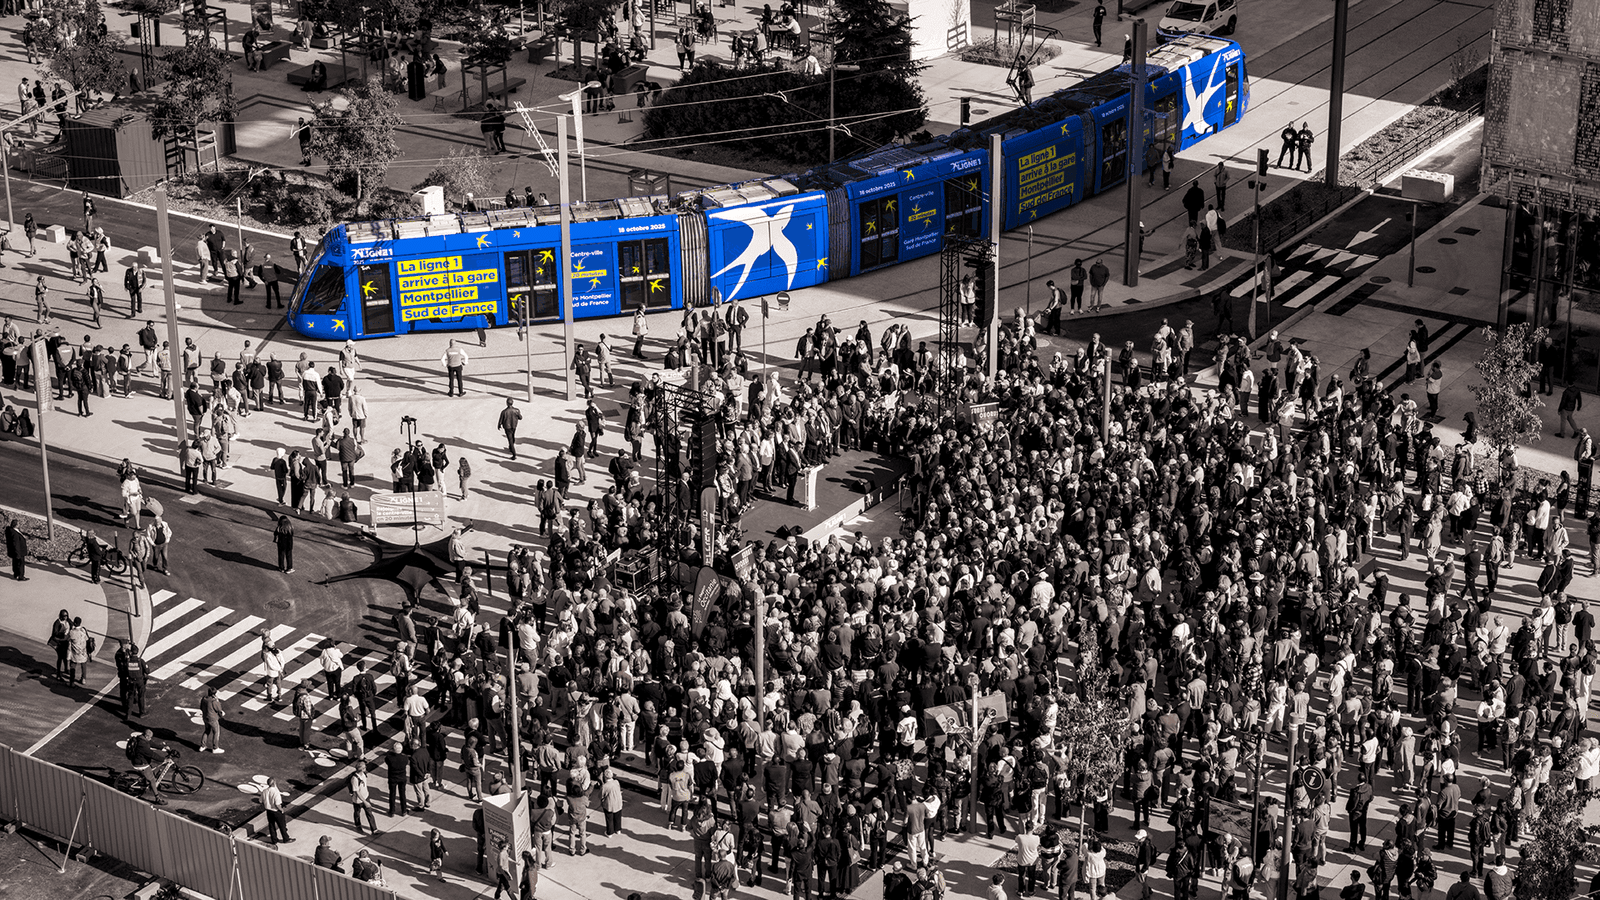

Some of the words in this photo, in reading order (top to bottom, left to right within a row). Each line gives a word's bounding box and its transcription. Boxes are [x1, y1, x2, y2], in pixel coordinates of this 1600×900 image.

[956, 159, 978, 170] LIGNE
[1020, 158, 1030, 168] La
[1031, 150, 1049, 164] ligne
[1050, 147, 1054, 156] 1
[1021, 168, 1043, 182] arrive
[1044, 164, 1049, 174] à
[1050, 162, 1057, 171] la
[1058, 156, 1075, 170] gare
[865, 186, 883, 194] octobre
[1021, 174, 1063, 197] Montpellier
[909, 190, 934, 201] Centre-ville
[1021, 198, 1035, 210] Sud
[1037, 195, 1047, 205] de
[1048, 185, 1072, 200] France
[915, 231, 939, 243] Montpellier
[921, 238, 937, 247] France
[360, 248, 387, 258] LIGNE
[400, 263, 416, 272] La
[419, 260, 450, 272] ligne
[454, 258, 459, 266] 1
[402, 276, 439, 288] arrive
[442, 274, 449, 284] à
[453, 273, 464, 283] la
[467, 271, 496, 283] gare
[403, 288, 475, 304] Montpellier
[580, 293, 612, 301] Montpellier
[404, 308, 429, 319] Sud
[432, 306, 448, 316] de
[452, 303, 494, 314] France
[700, 578, 717, 608] Occitanie
